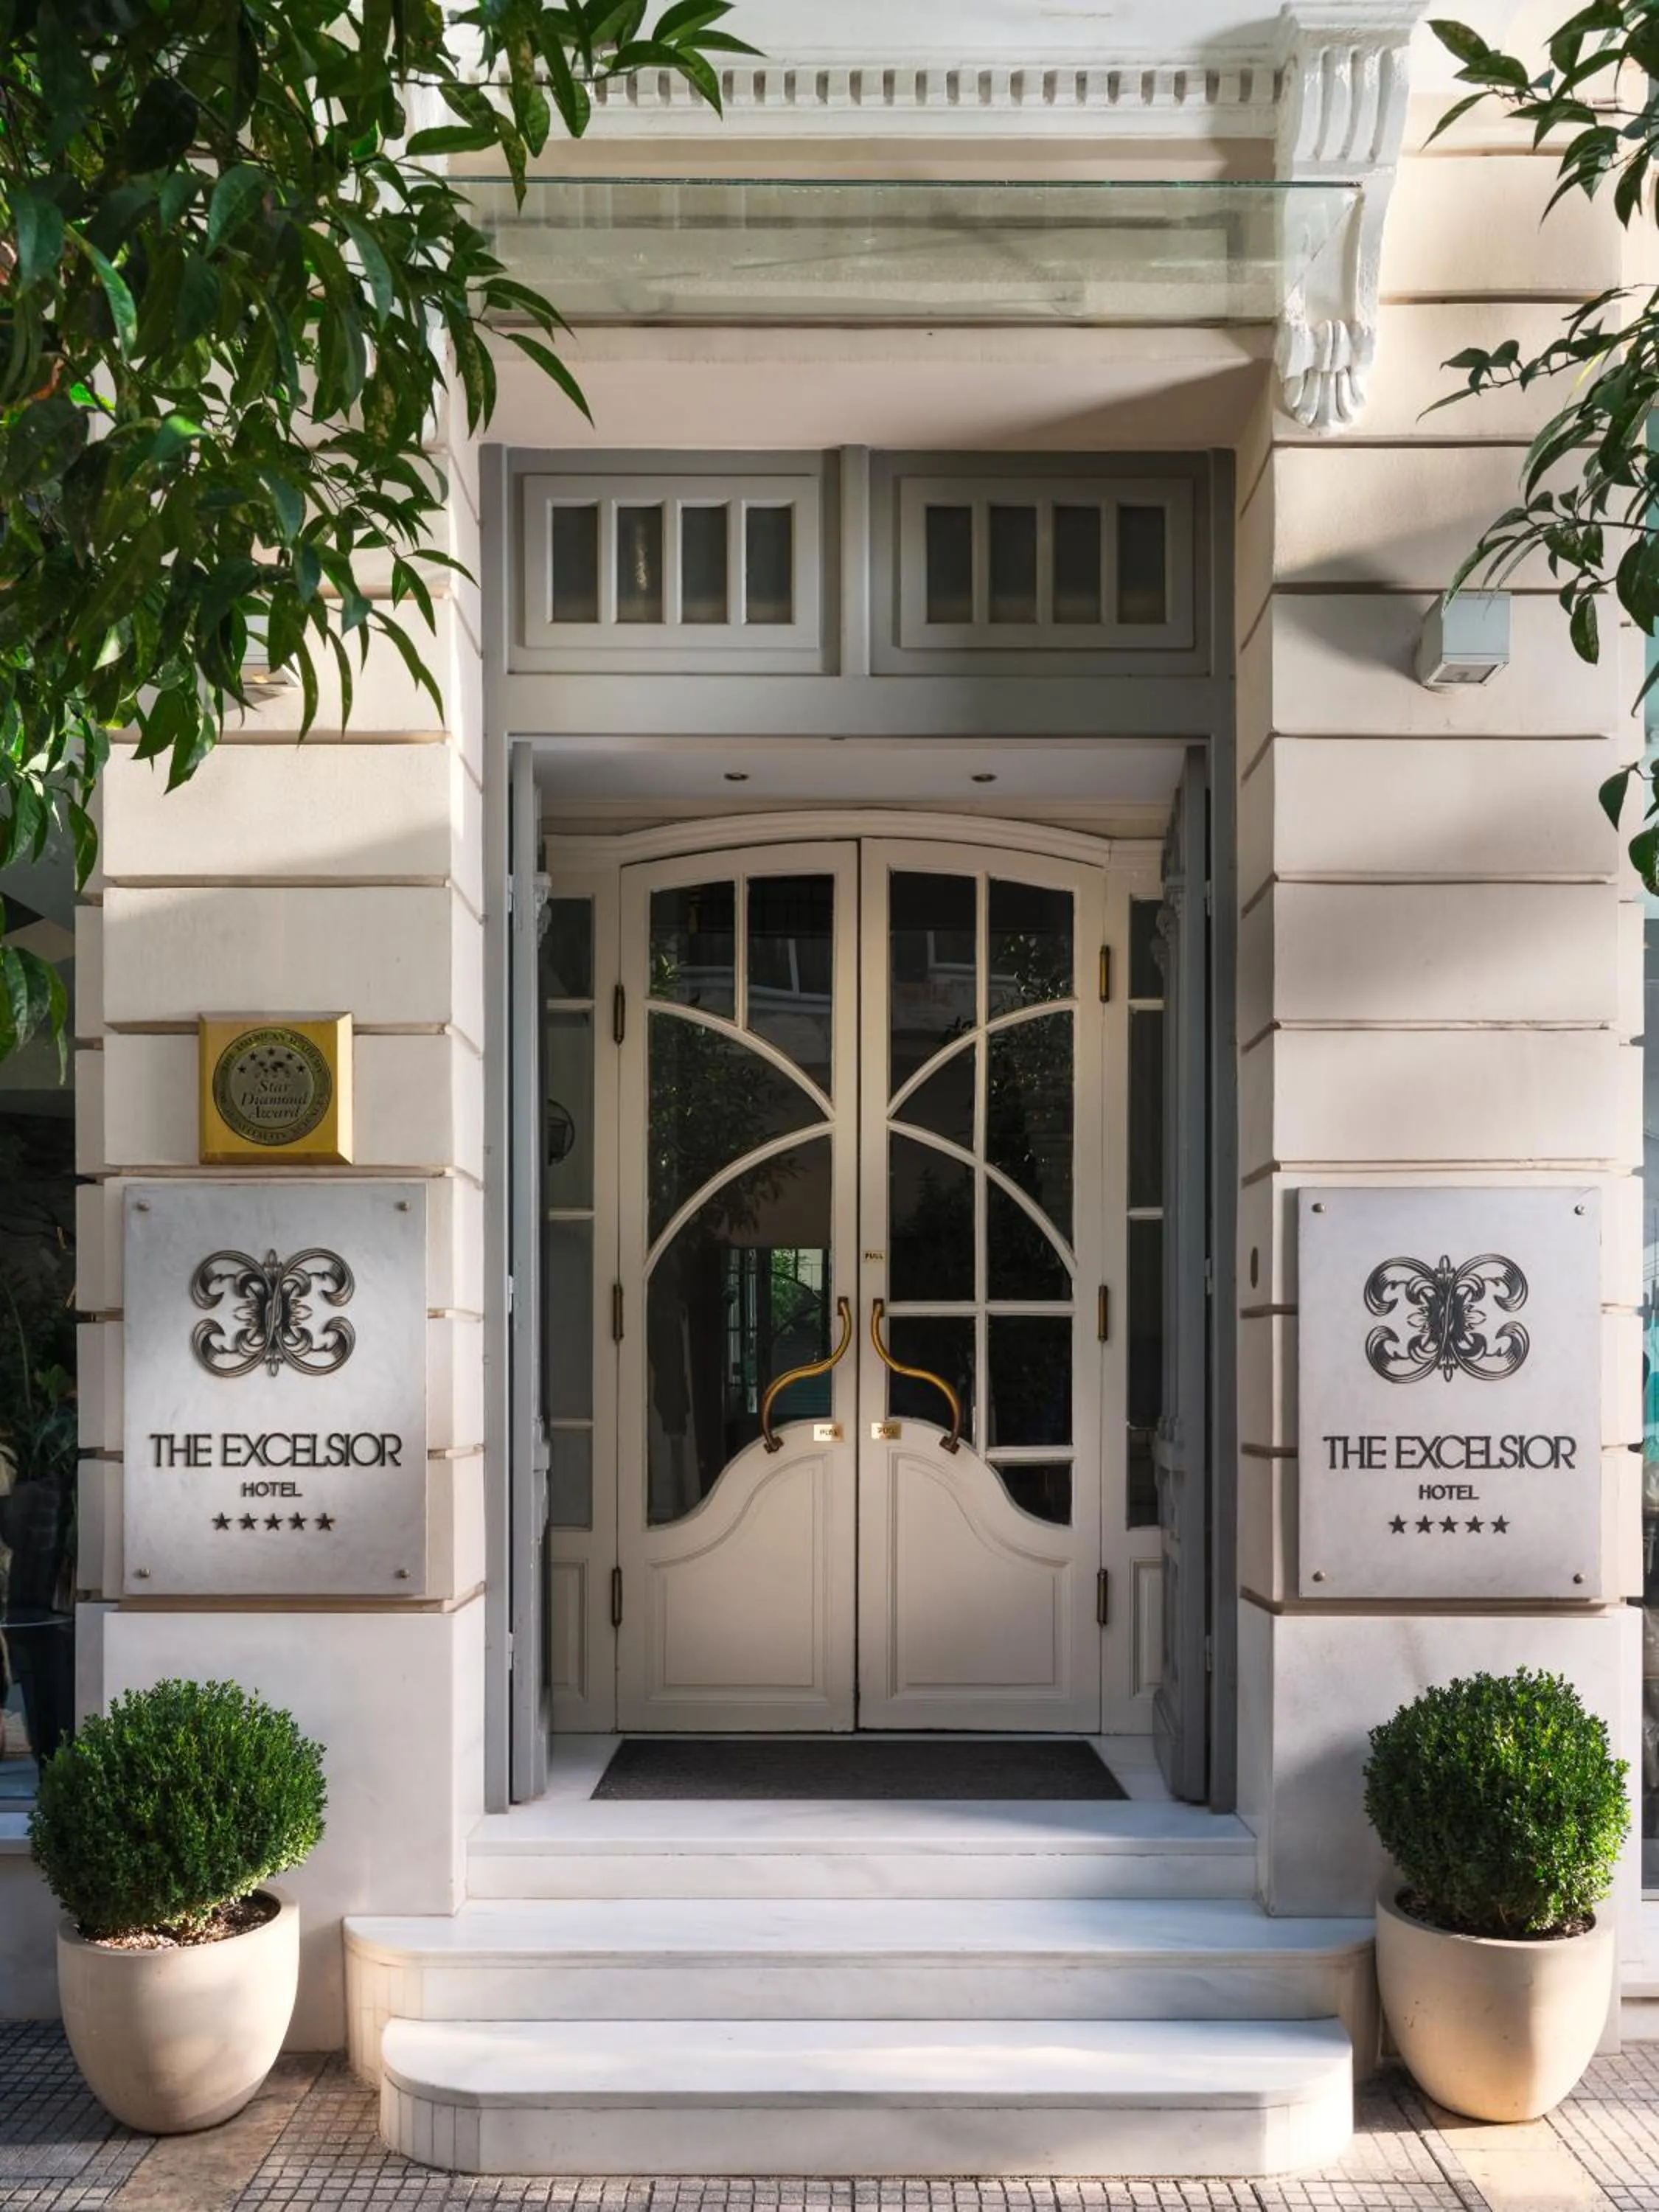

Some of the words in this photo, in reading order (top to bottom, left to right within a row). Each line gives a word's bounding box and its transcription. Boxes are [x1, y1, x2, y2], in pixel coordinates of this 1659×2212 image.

[258, 1079, 291, 1093] Star
[240, 1092, 308, 1107] Diamond
[248, 1105, 302, 1119] Award
[148, 1433, 212, 1468] THE
[220, 1431, 403, 1468] EXCELSIOR
[1322, 1436, 1387, 1470] THE
[1394, 1434, 1577, 1470] EXCELSIOR
[240, 1481, 303, 1498] HOTEL
[1418, 1484, 1480, 1500] HOTEL
